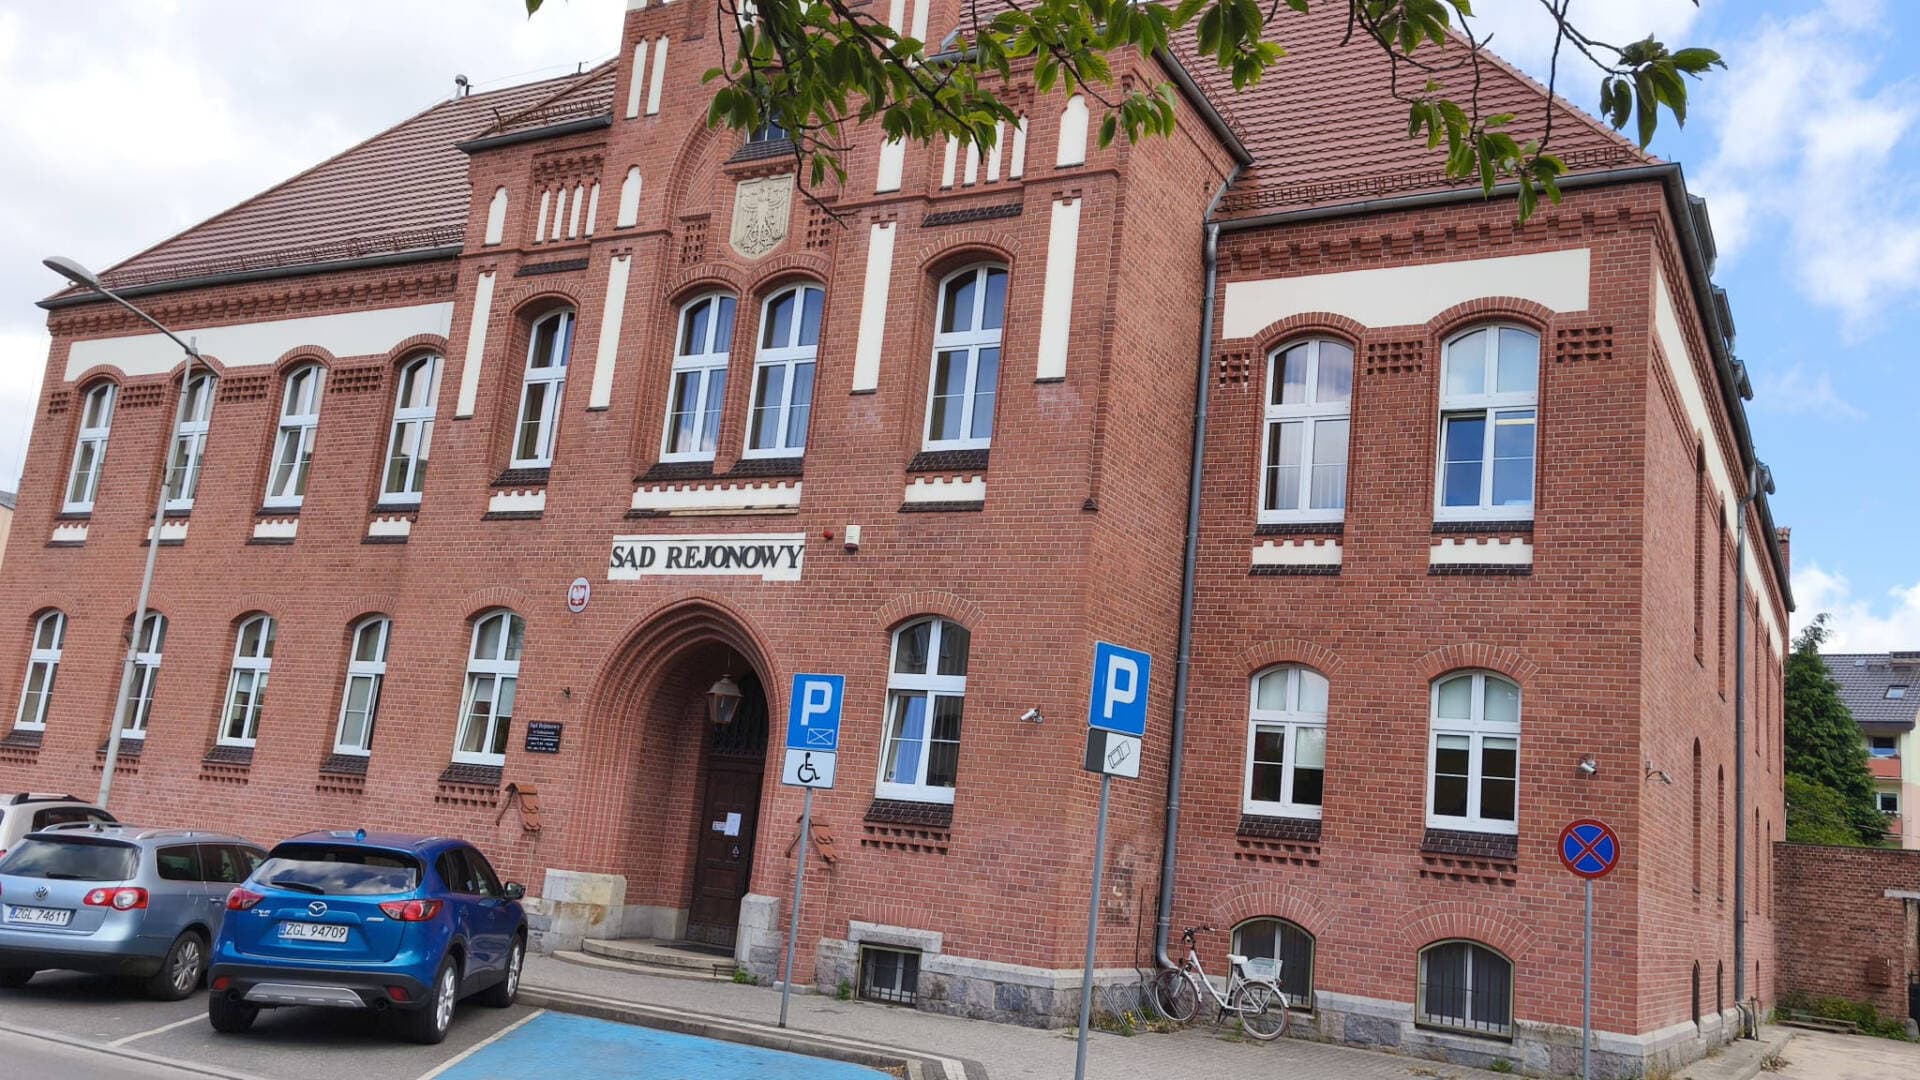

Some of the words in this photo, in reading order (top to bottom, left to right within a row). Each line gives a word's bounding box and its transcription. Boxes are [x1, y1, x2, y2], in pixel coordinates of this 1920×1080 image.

[611, 545, 656, 571] SĄD
[665, 545, 804, 569] REJONOWY
[1104, 654, 1138, 719] P
[801, 681, 833, 726] P
[15, 907, 32, 920] ZGL
[36, 909, 67, 922] 74611
[286, 923, 306, 936] ZGL
[311, 925, 346, 938] 94709
